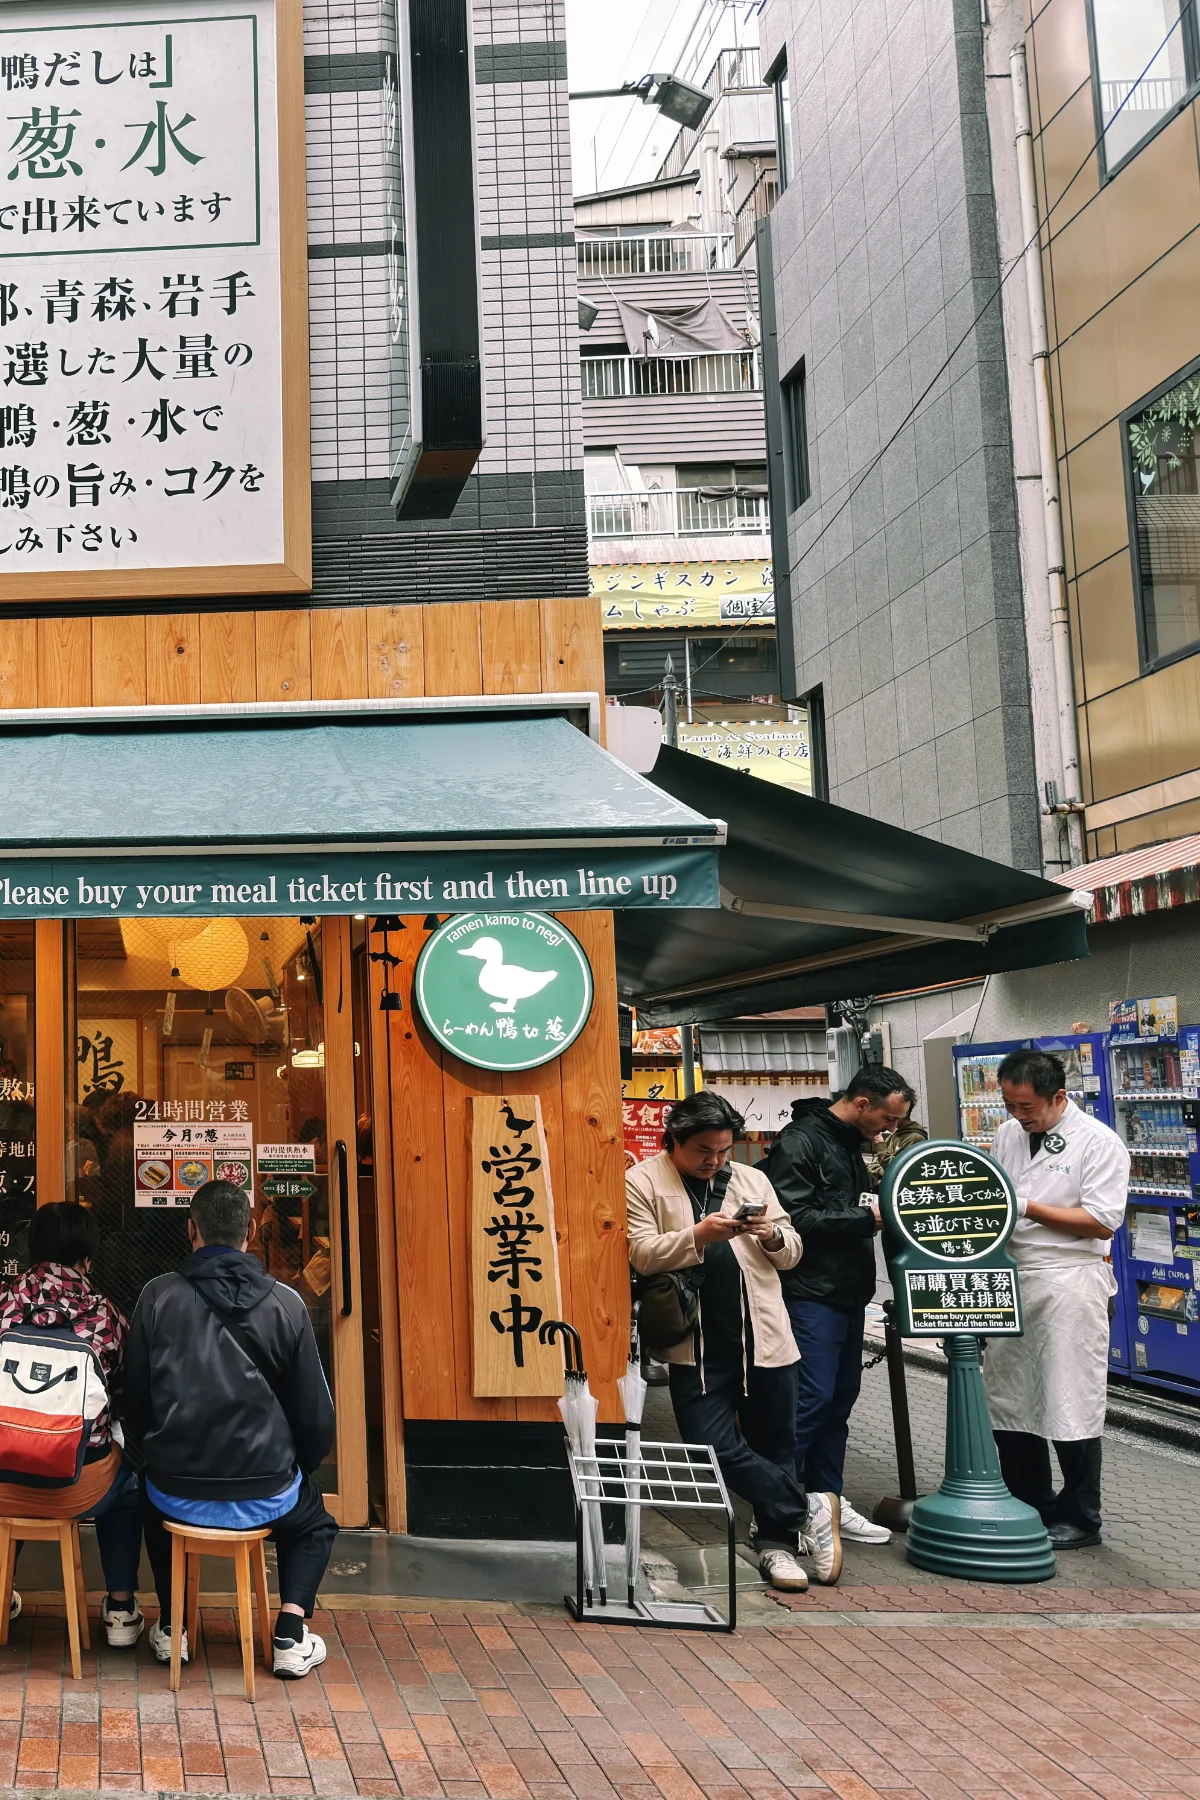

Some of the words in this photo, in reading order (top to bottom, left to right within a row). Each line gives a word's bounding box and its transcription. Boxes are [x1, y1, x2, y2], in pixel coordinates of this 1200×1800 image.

[606, 570, 739, 591] ジンギスカン
[680, 734, 722, 742] Lamb
[745, 731, 804, 741] Seafood
[684, 743, 809, 759] と海鮮のお店
[77, 876, 127, 909] buy
[136, 882, 203, 909] your
[211, 875, 278, 904] meal
[287, 874, 367, 902] ticket
[374, 872, 434, 901] first
[443, 871, 496, 900] and
[505, 870, 569, 898] then
[577, 868, 632, 896] line
[641, 873, 677, 900] up
[446, 918, 484, 944] ramen
[484, 914, 520, 926] kamo
[522, 917, 535, 931] to
[535, 923, 564, 947] negi
[134, 1100, 249, 1121] 24時間営業
[162, 1129, 219, 1142] 今月の葱
[1045, 1135, 1064, 1152] 32
[921, 1159, 976, 1178] お先に
[899, 1184, 1005, 1205] 食券を買ってから
[913, 1215, 1000, 1234] お並び下さい
[481, 1143, 544, 1368] 営業中
[910, 1273, 1011, 1291] 請購買餐券
[940, 1292, 1013, 1308] 後再排隊
[914, 1320, 937, 1328] ticket
[950, 1312, 964, 1321] buy
